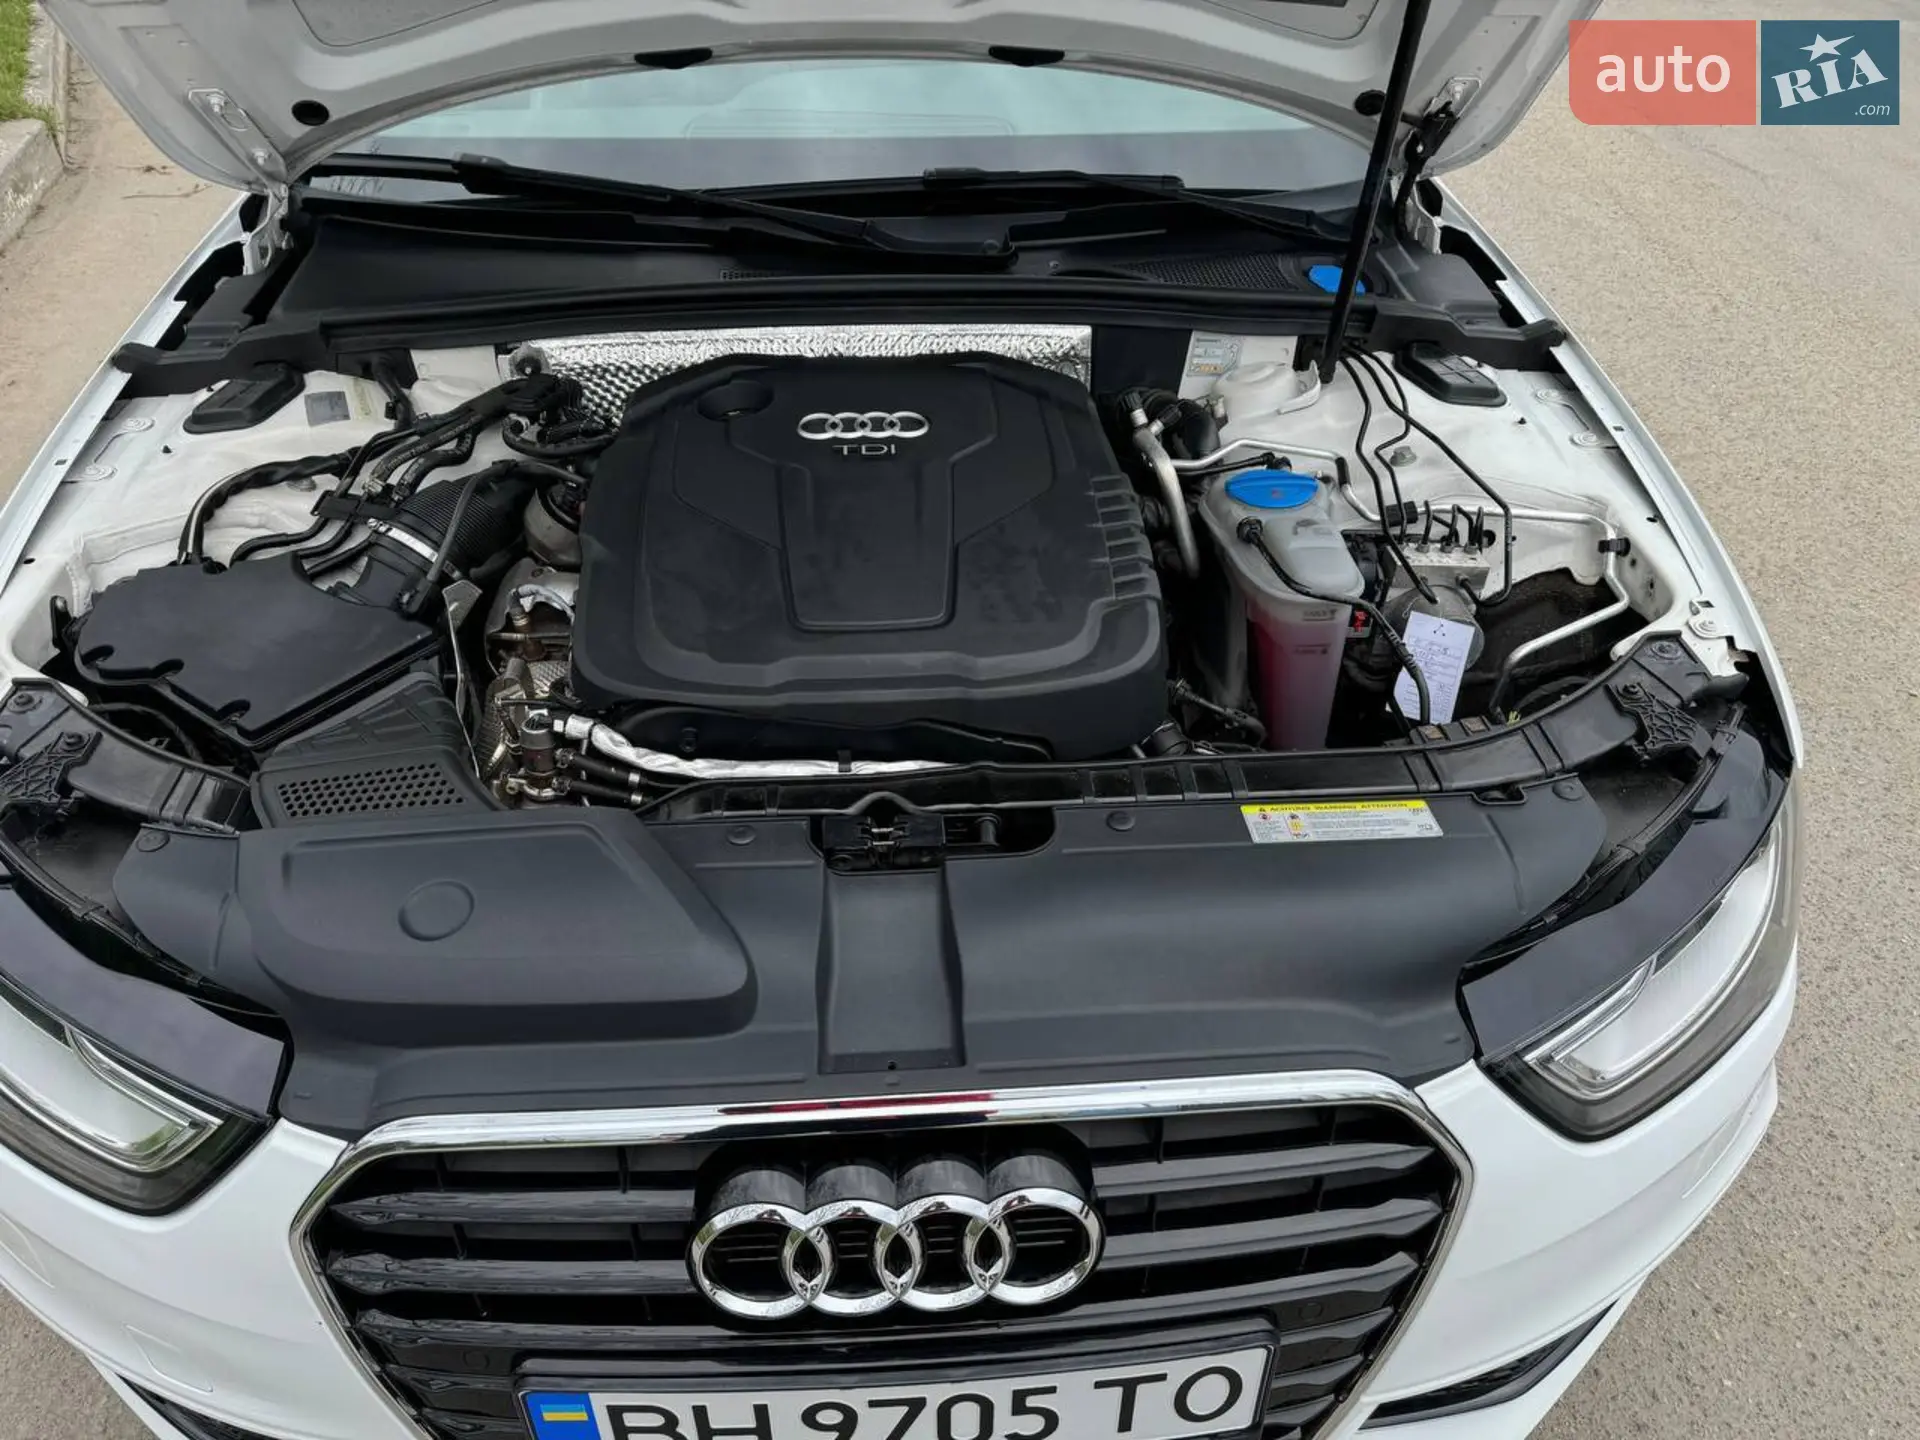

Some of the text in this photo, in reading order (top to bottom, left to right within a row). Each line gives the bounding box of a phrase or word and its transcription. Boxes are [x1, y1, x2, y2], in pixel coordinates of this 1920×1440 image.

[832, 443, 896, 456] TDI
[606, 1366, 1243, 1440] BH 9705 TO
